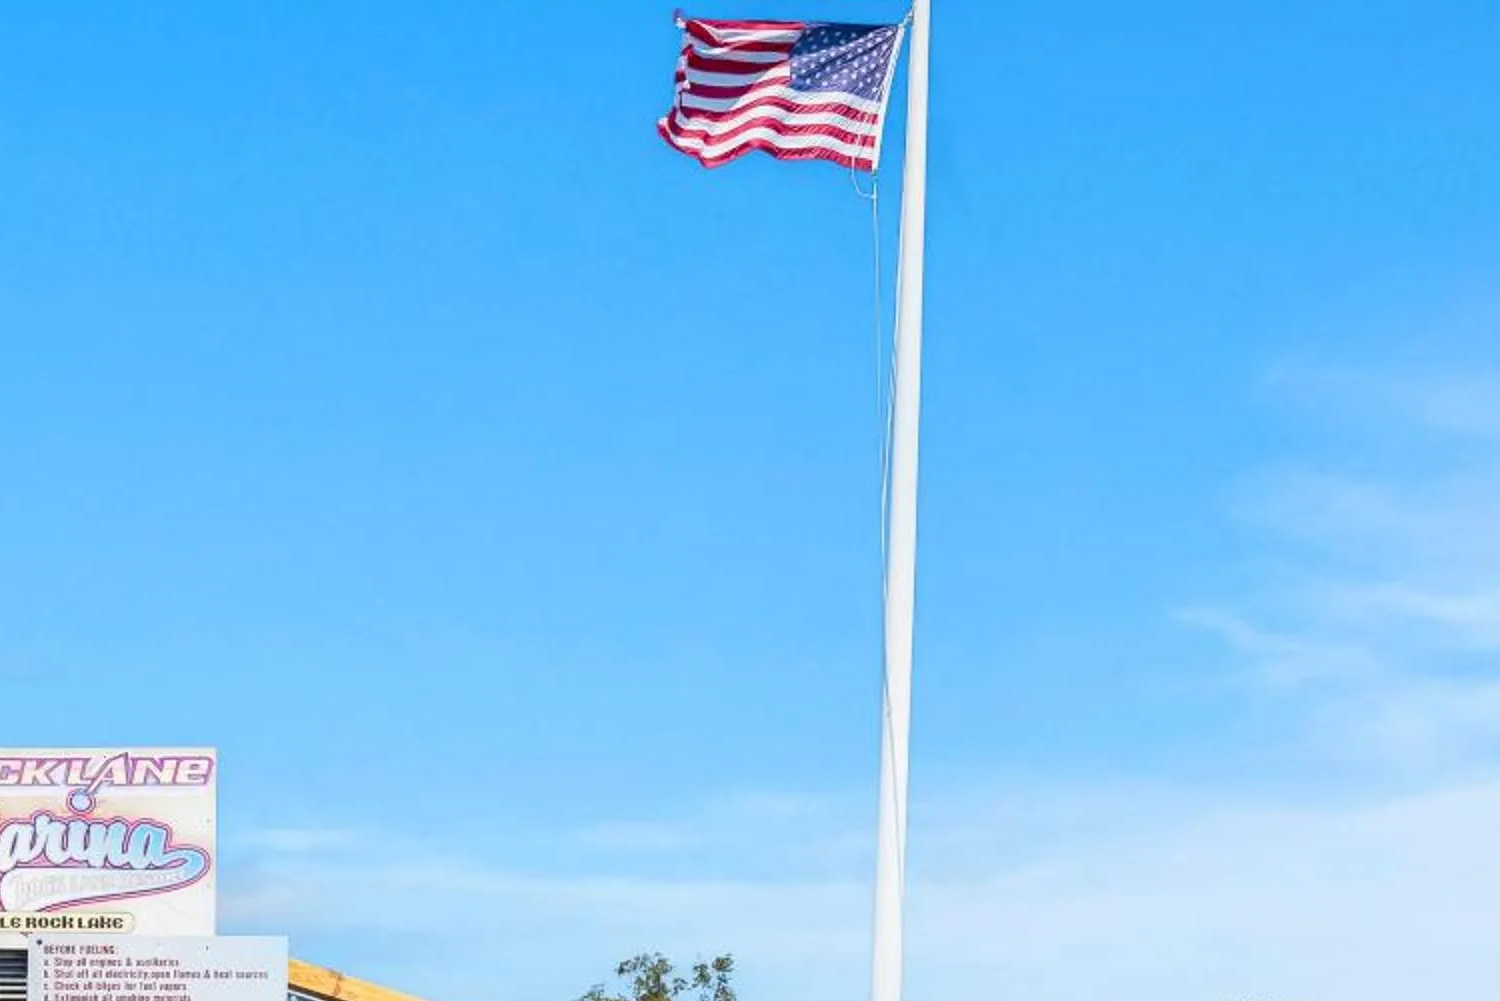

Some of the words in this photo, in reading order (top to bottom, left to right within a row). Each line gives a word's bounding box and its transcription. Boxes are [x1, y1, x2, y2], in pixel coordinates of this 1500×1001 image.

[25, 916, 74, 929] ROCK
[77, 916, 124, 929] LAKE
[44, 945, 75, 955] BEFORE
[54, 958, 73, 968] Stop
[54, 982, 79, 991] Check
